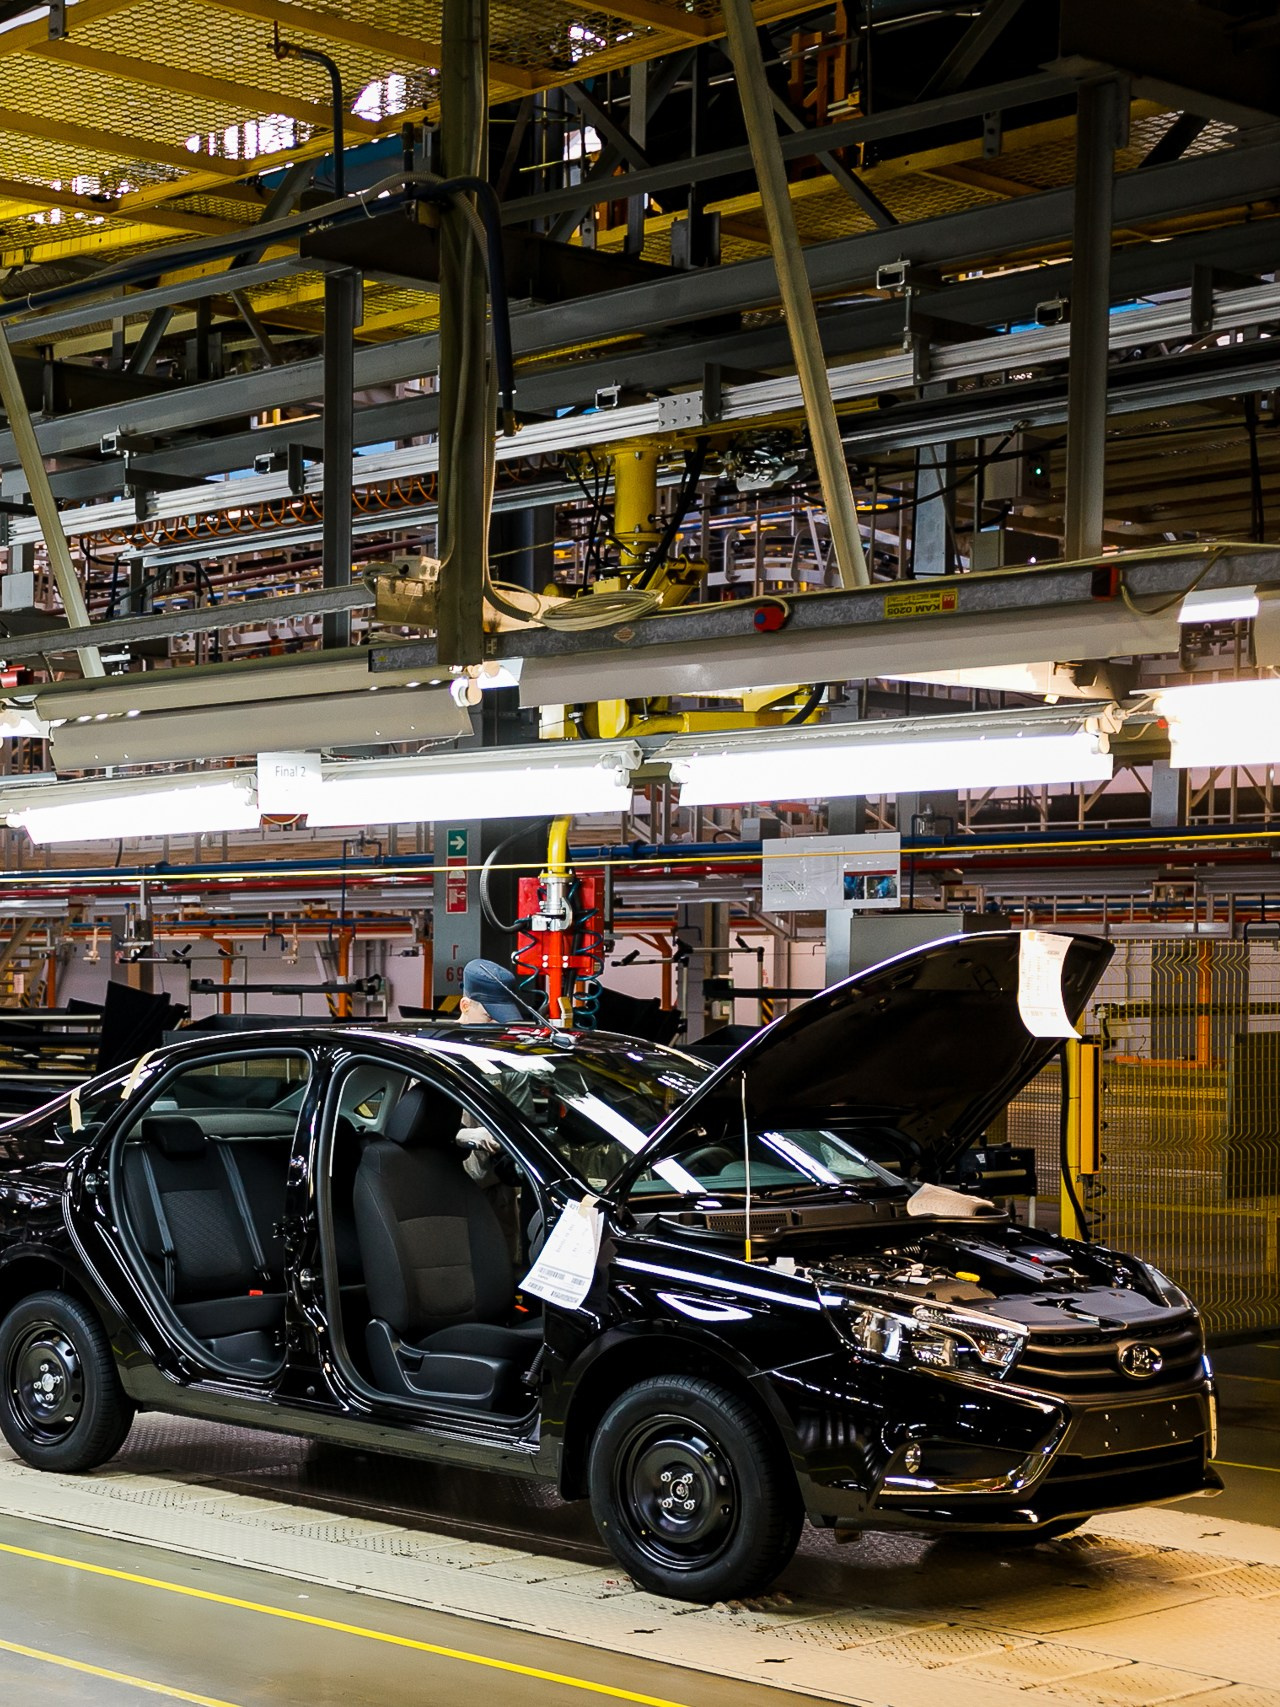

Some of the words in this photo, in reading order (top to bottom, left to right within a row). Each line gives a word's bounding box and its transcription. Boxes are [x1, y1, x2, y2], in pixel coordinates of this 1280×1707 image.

[887, 606, 913, 616] 0205
[915, 604, 940, 613] KAM
[275, 765, 298, 777] Final
[300, 766, 306, 777] 2
[446, 966, 464, 982] 69
